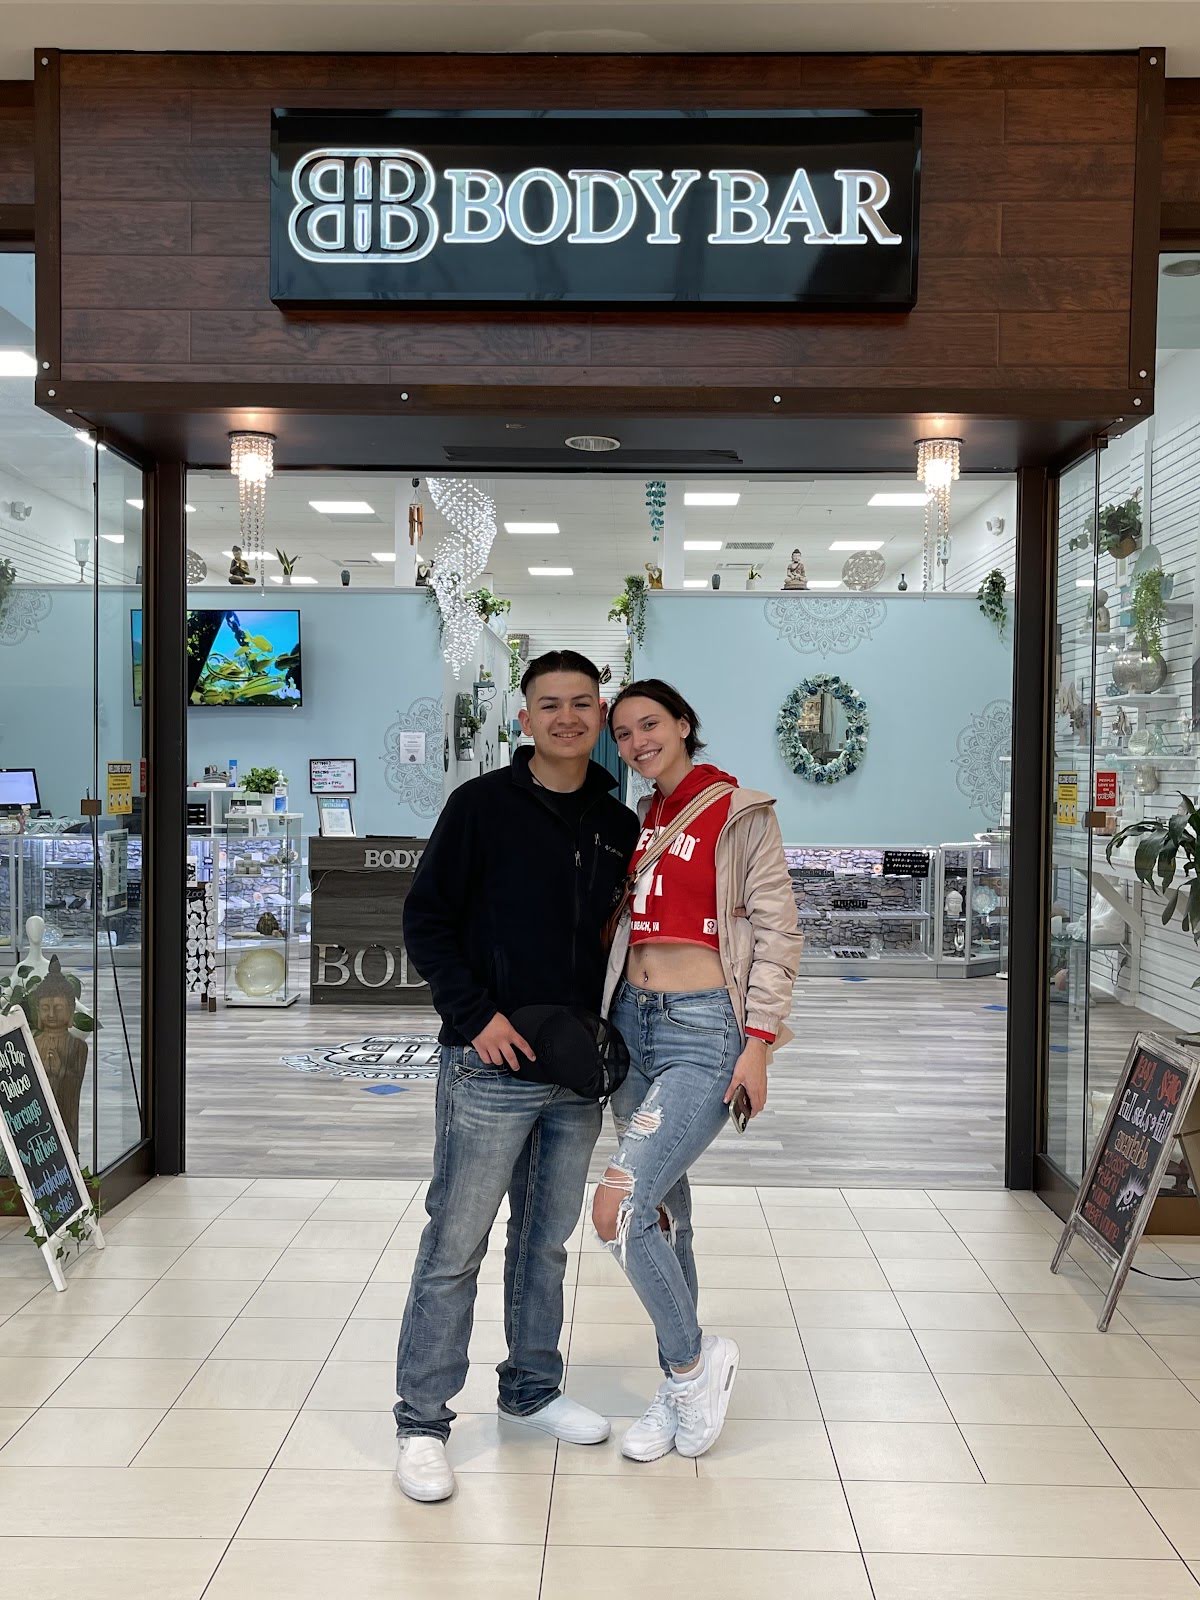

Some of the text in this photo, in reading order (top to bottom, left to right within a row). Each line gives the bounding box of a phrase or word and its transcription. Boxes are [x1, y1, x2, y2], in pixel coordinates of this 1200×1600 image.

[443, 167, 902, 246] BODY BAR
[4, 1098, 43, 1137] Piercings
[26, 1121, 59, 1167] Tattoos
